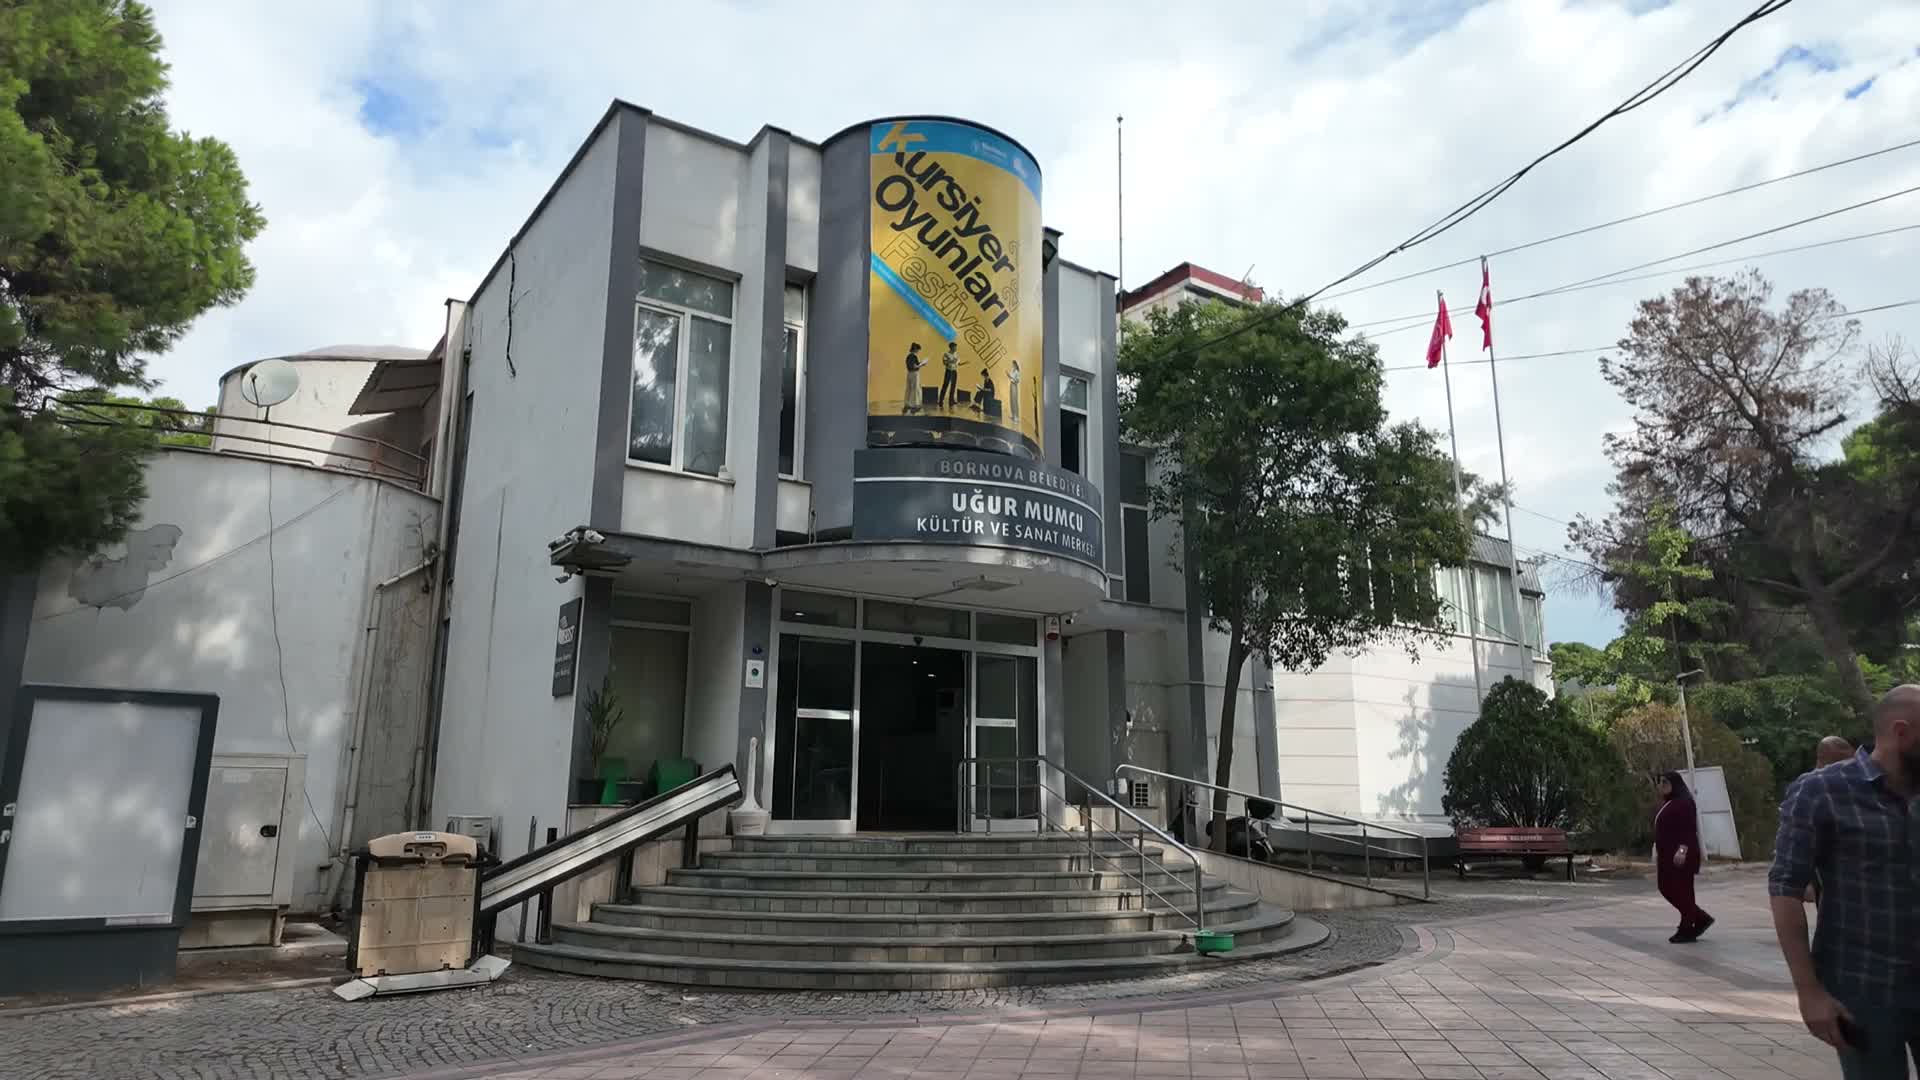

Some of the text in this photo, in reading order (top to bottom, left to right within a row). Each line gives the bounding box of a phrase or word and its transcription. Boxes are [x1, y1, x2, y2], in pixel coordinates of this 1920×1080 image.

[877, 121, 1015, 273] Kursiyer
[875, 174, 1010, 328] Oyunları
[880, 232, 1007, 369] Festivali
[940, 460, 1024, 481] BORNOVA
[952, 489, 1083, 532] UĞUR MUMCU
[917, 514, 985, 535] KÜLTÜR
[990, 522, 1010, 537] VE
[1015, 524, 1059, 545] SANAT
